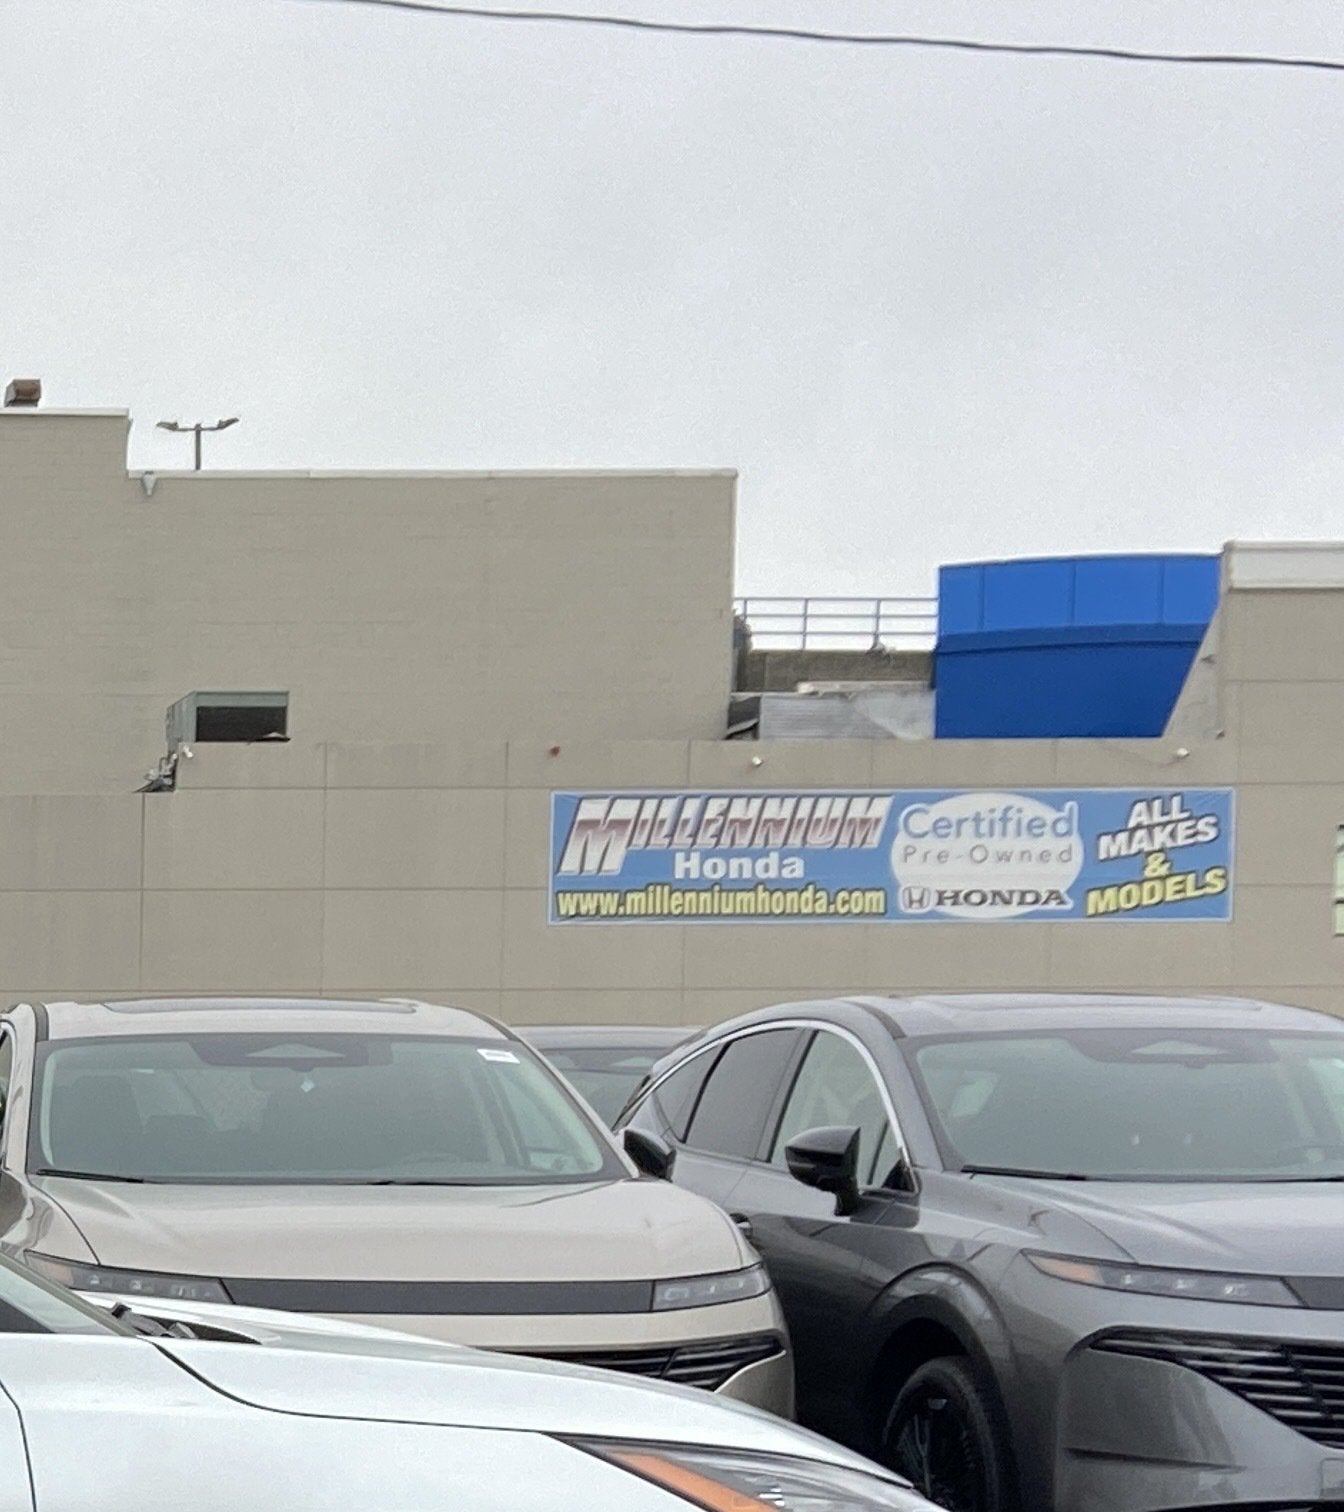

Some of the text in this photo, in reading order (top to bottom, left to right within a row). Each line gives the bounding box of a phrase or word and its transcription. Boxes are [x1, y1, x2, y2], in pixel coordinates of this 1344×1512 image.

[902, 802, 1074, 840] Certified
[1127, 793, 1192, 829] ALL
[556, 795, 896, 876] MILLENNIUM
[1097, 815, 1221, 862] MAKES
[674, 851, 806, 880] Honda
[903, 844, 1073, 865] Pre-Owned
[1143, 851, 1173, 879] &
[556, 883, 888, 917] www.millenniumhonda.com
[935, 888, 1069, 908] HONDA
[1085, 867, 1228, 917] MODELS
